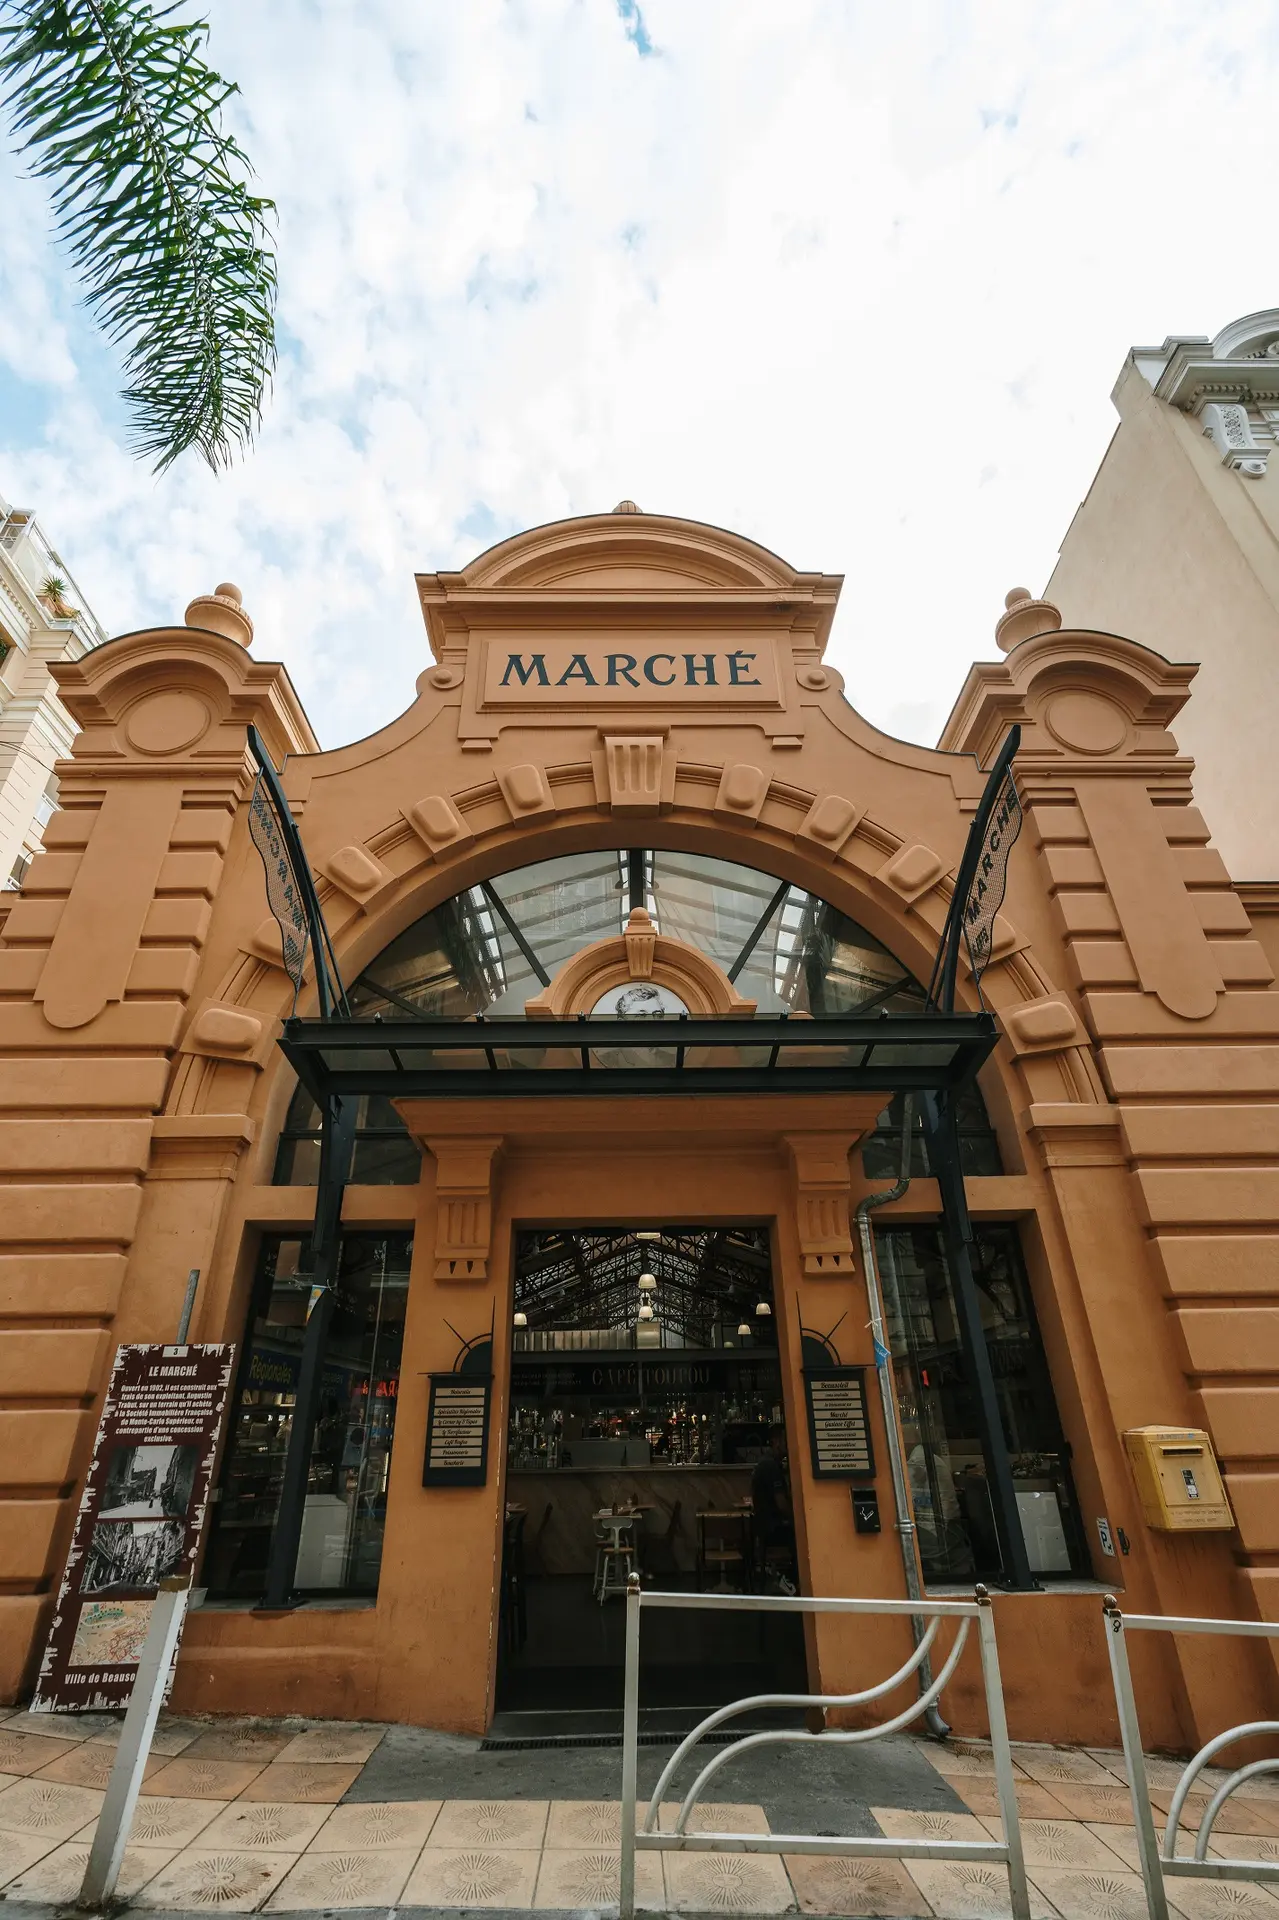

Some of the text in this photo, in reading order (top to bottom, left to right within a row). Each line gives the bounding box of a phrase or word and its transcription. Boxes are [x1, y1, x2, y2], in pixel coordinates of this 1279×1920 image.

[498, 650, 762, 688] MARCHÉ
[149, 1364, 198, 1376] LE MARCHÉ
[249, 1354, 292, 1386] Régionales
[185, 1409, 213, 1417] Française
[65, 1673, 136, 1684] Ville de Beauso
